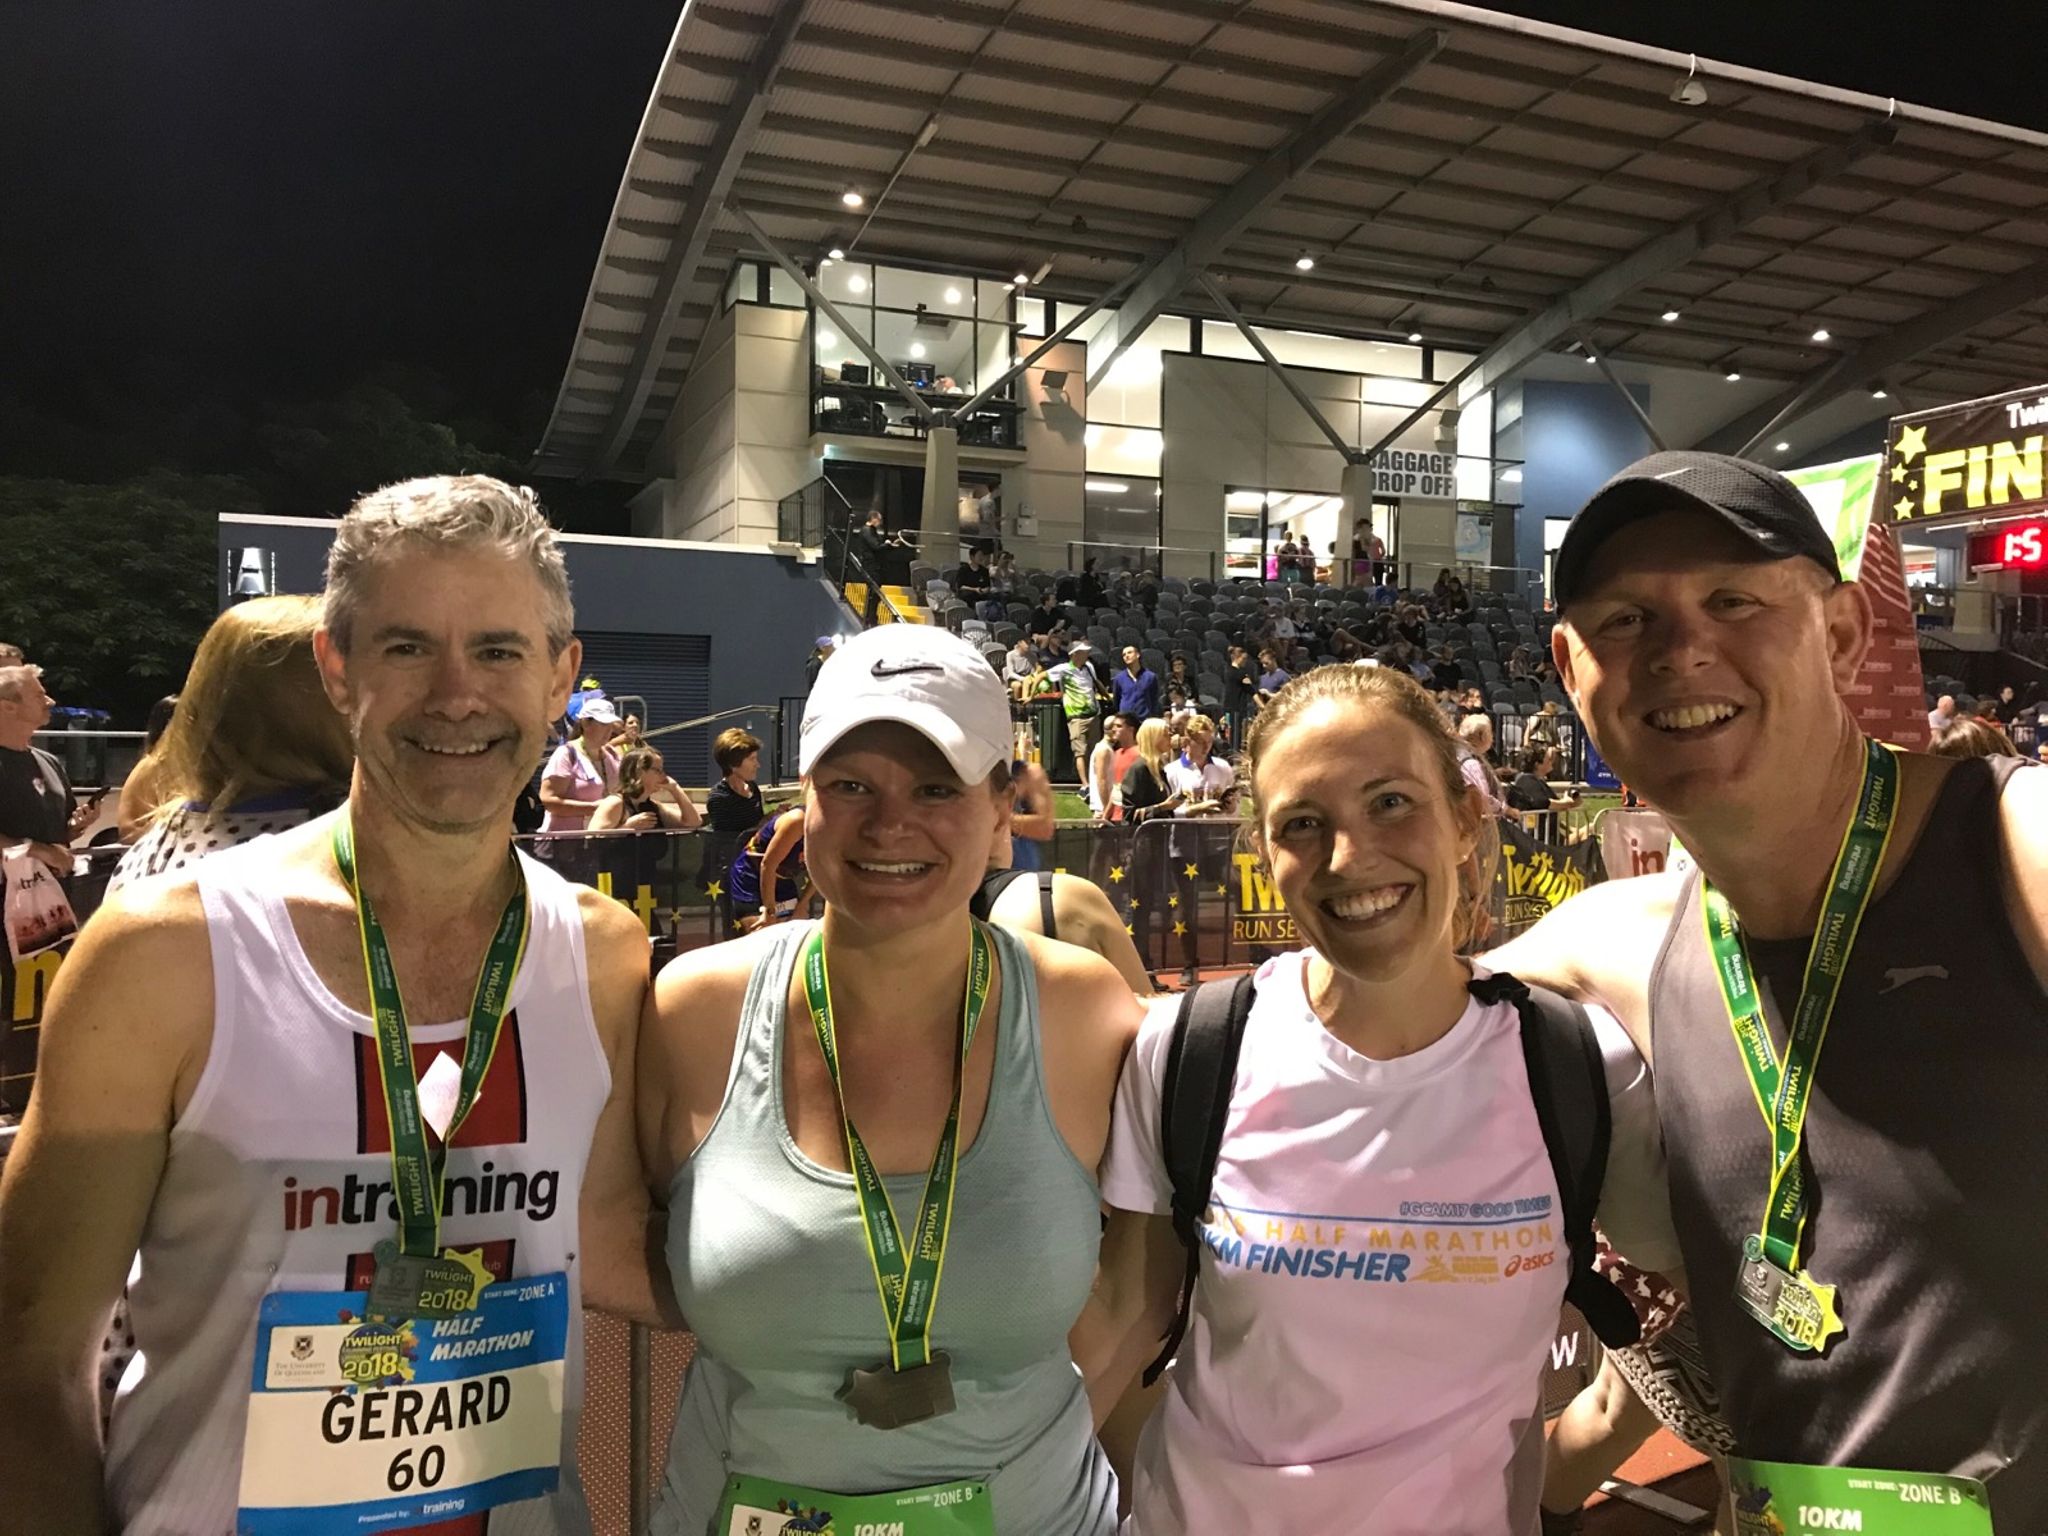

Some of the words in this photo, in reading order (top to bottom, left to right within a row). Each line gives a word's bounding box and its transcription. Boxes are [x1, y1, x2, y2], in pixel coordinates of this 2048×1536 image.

[1421, 475, 1453, 496] OFF
[1923, 435, 2044, 515] FIN
[1864, 775, 1885, 829] TWILIGHT
[1233, 920, 1272, 939] RUN
[1276, 919, 1301, 938] SE
[1819, 912, 1846, 974] TWILIGHT
[482, 961, 504, 1013] TWILIGHT
[1732, 953, 1747, 996] intraining
[388, 1009, 405, 1067] TWILIGHT
[1743, 1014, 1769, 1073] TWILIGHT
[1781, 1064, 1802, 1131] TWILIGHT
[284, 1161, 560, 1231] intrning
[407, 1155, 425, 1216] TWILIGHT
[1400, 1201, 1469, 1218] #GCAM17
[920, 1203, 939, 1261] TWILIGHT
[1265, 1218, 1347, 1246] HALF
[1369, 1220, 1553, 1253] MARATHON
[424, 1265, 476, 1284] TWILIGHT
[1246, 1243, 1412, 1283] FINISHER
[1522, 1251, 1555, 1272] asics
[418, 1287, 469, 1312] 2018
[518, 1283, 546, 1302] ZONE
[547, 1281, 555, 1297] A
[903, 1280, 919, 1323] intraining
[344, 1333, 402, 1348] TWILIGHT
[430, 1329, 535, 1362] MARATHON
[432, 1315, 484, 1338] HALF
[343, 1352, 398, 1379] 2018
[321, 1374, 511, 1444] GERARD
[387, 1444, 446, 1492] 60
[933, 1490, 963, 1507] ZONE
[965, 1488, 973, 1501] B
[1899, 1484, 1945, 1504] ZONE
[1950, 1488, 1961, 1505] B
[1798, 1505, 1862, 1532] 10KM
